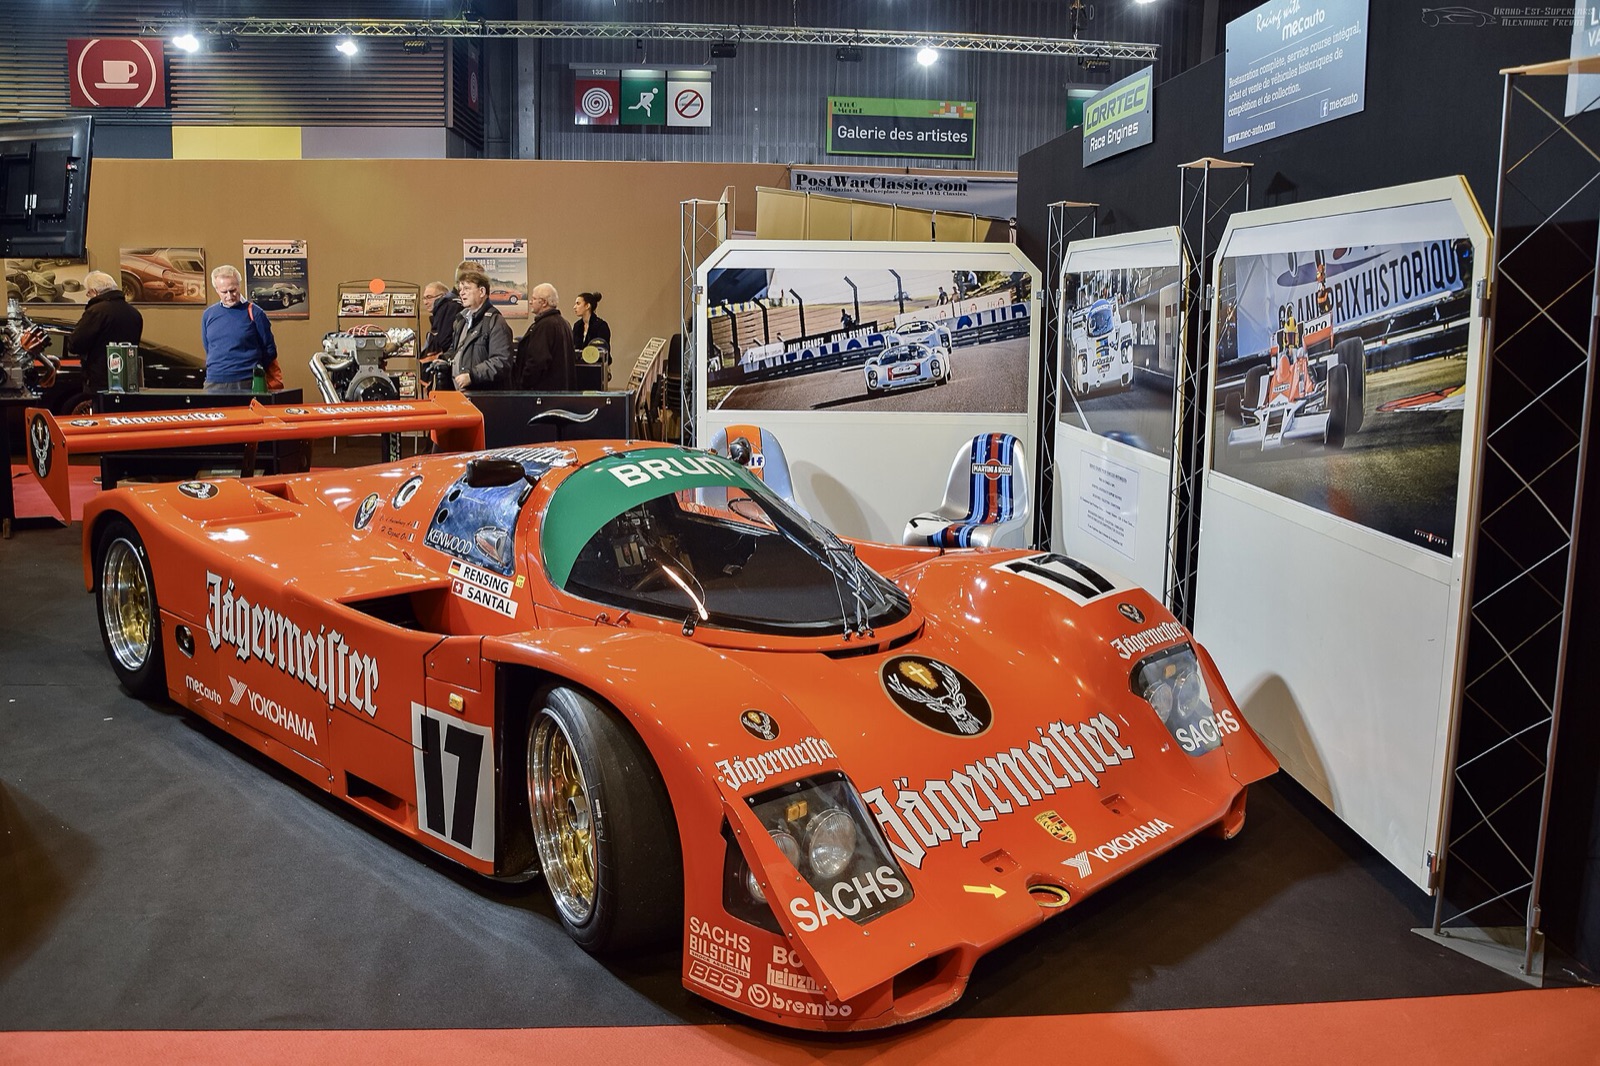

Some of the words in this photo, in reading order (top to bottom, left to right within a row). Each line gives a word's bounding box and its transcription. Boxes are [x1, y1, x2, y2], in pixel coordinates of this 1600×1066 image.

[1256, 9, 1281, 33] Racing
[1282, 0, 1301, 19] with
[1281, 8, 1326, 41] mecauto
[1591, 6, 1600, 26] L
[1228, 66, 1259, 89] Restauration
[1287, 47, 1310, 63] service
[1310, 37, 1332, 54] course
[1228, 90, 1242, 103] achat
[1242, 88, 1248, 98] et
[1248, 81, 1262, 94] vente
[1262, 76, 1271, 88] de
[1271, 67, 1298, 86] véhicules
[1298, 52, 1333, 75] historiques
[1333, 47, 1344, 60] de
[1086, 83, 1146, 130] LORRTEC
[1228, 98, 1258, 118] compétition
[1257, 97, 1264, 107] et
[1263, 92, 1271, 104] de
[1271, 83, 1301, 101] collection.
[1329, 92, 1359, 111] mecauto
[837, 125, 886, 140] Galerie
[889, 127, 914, 141] des
[916, 128, 968, 143] artistes
[1089, 135, 1106, 152] Race
[1107, 121, 1139, 144] Engines
[1227, 120, 1276, 144] www.mec-auto.com
[795, 173, 968, 192] PostWarClassic.com
[248, 246, 303, 255] Octane
[468, 245, 524, 254] Octane
[253, 264, 281, 277] XKSS
[428, 527, 473, 555] KENWOOD
[463, 566, 509, 594] RENSING
[1004, 553, 1117, 600] 17
[467, 587, 512, 615] SANTAL
[185, 675, 222, 706] mecauto
[248, 687, 318, 745] YOKOHAMA
[1175, 709, 1240, 752] SACHS
[420, 713, 485, 850] 17
[1088, 818, 1174, 863] YOKOHAMA
[789, 865, 904, 932] SACHS
[689, 916, 751, 953] SACHS
[689, 933, 751, 972] BILSTEIN
[688, 959, 743, 998] BBS
[772, 992, 852, 1017] brembo
